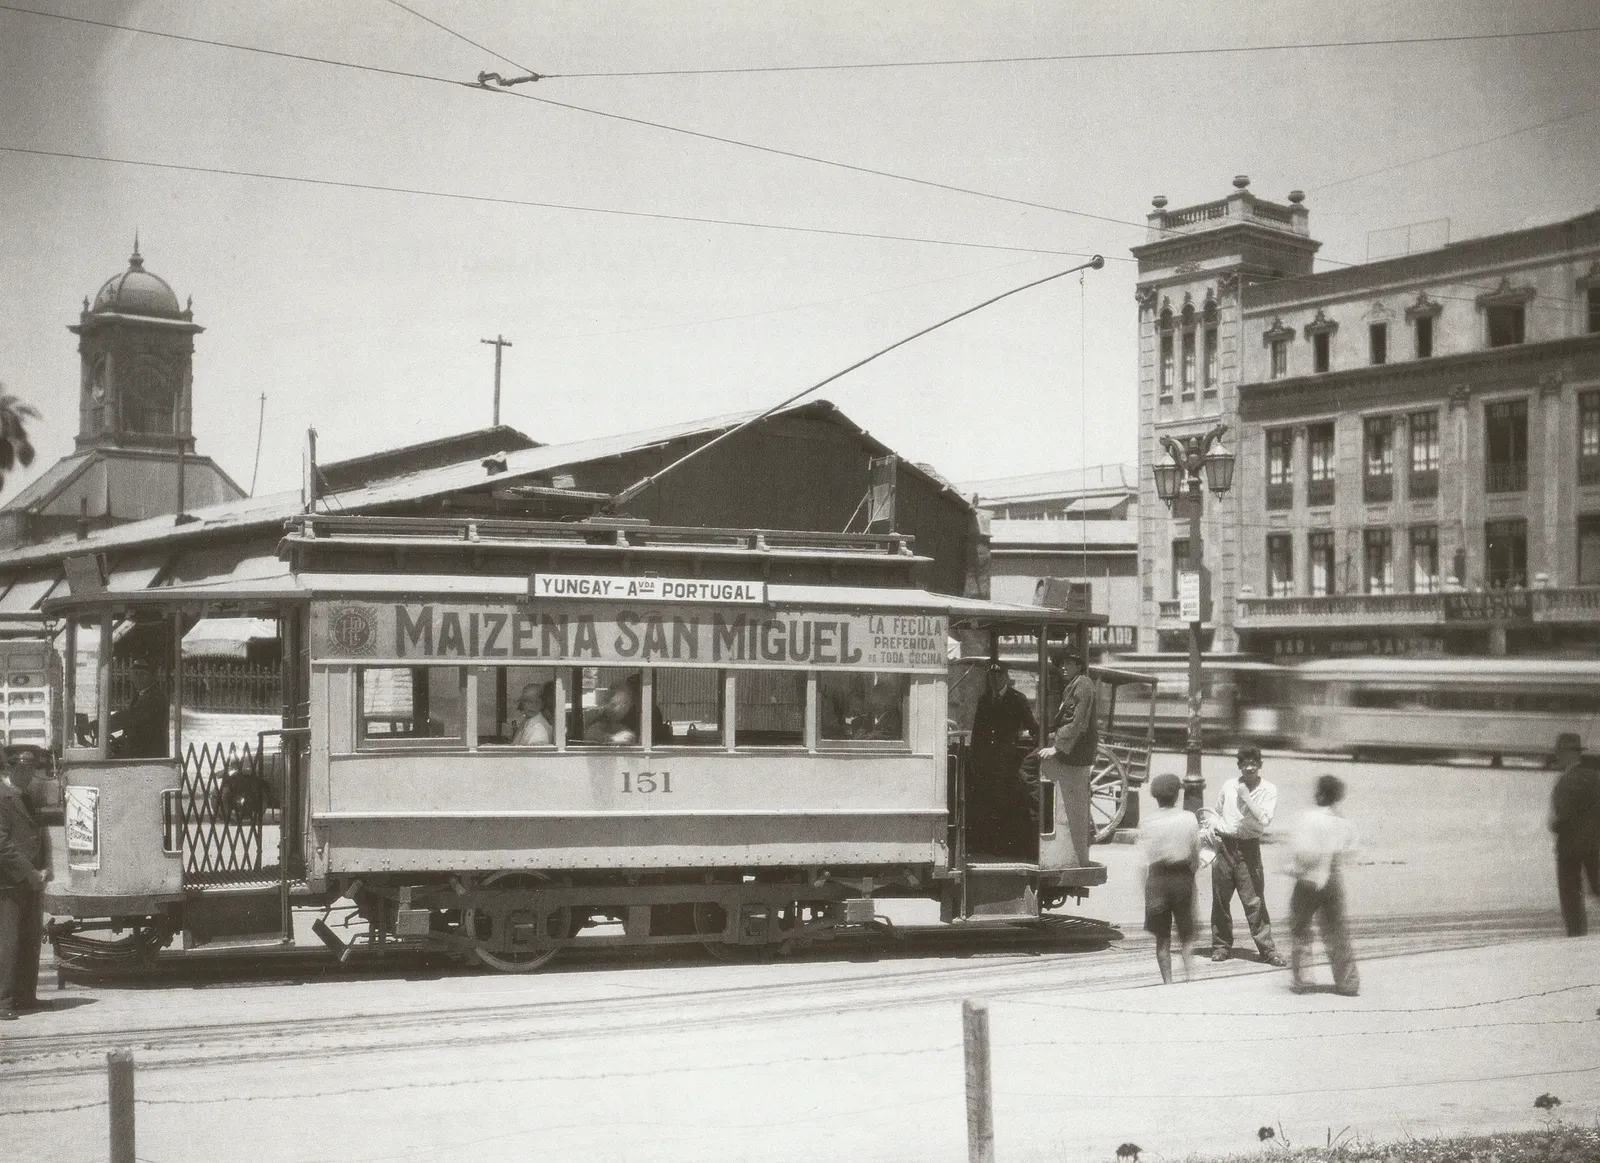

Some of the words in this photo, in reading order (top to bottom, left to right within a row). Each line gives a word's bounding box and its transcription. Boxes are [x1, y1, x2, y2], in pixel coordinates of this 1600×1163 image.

[662, 582, 756, 600] PORTUGAL
[395, 604, 601, 659] MAIZENA
[613, 610, 698, 660] SAN
[712, 612, 862, 664] MIGUEL
[868, 616, 884, 634] LA
[874, 637, 936, 650] PREFERIDA
[881, 651, 904, 664] TODA
[908, 652, 942, 665] COCINA
[620, 771, 674, 794] 151
